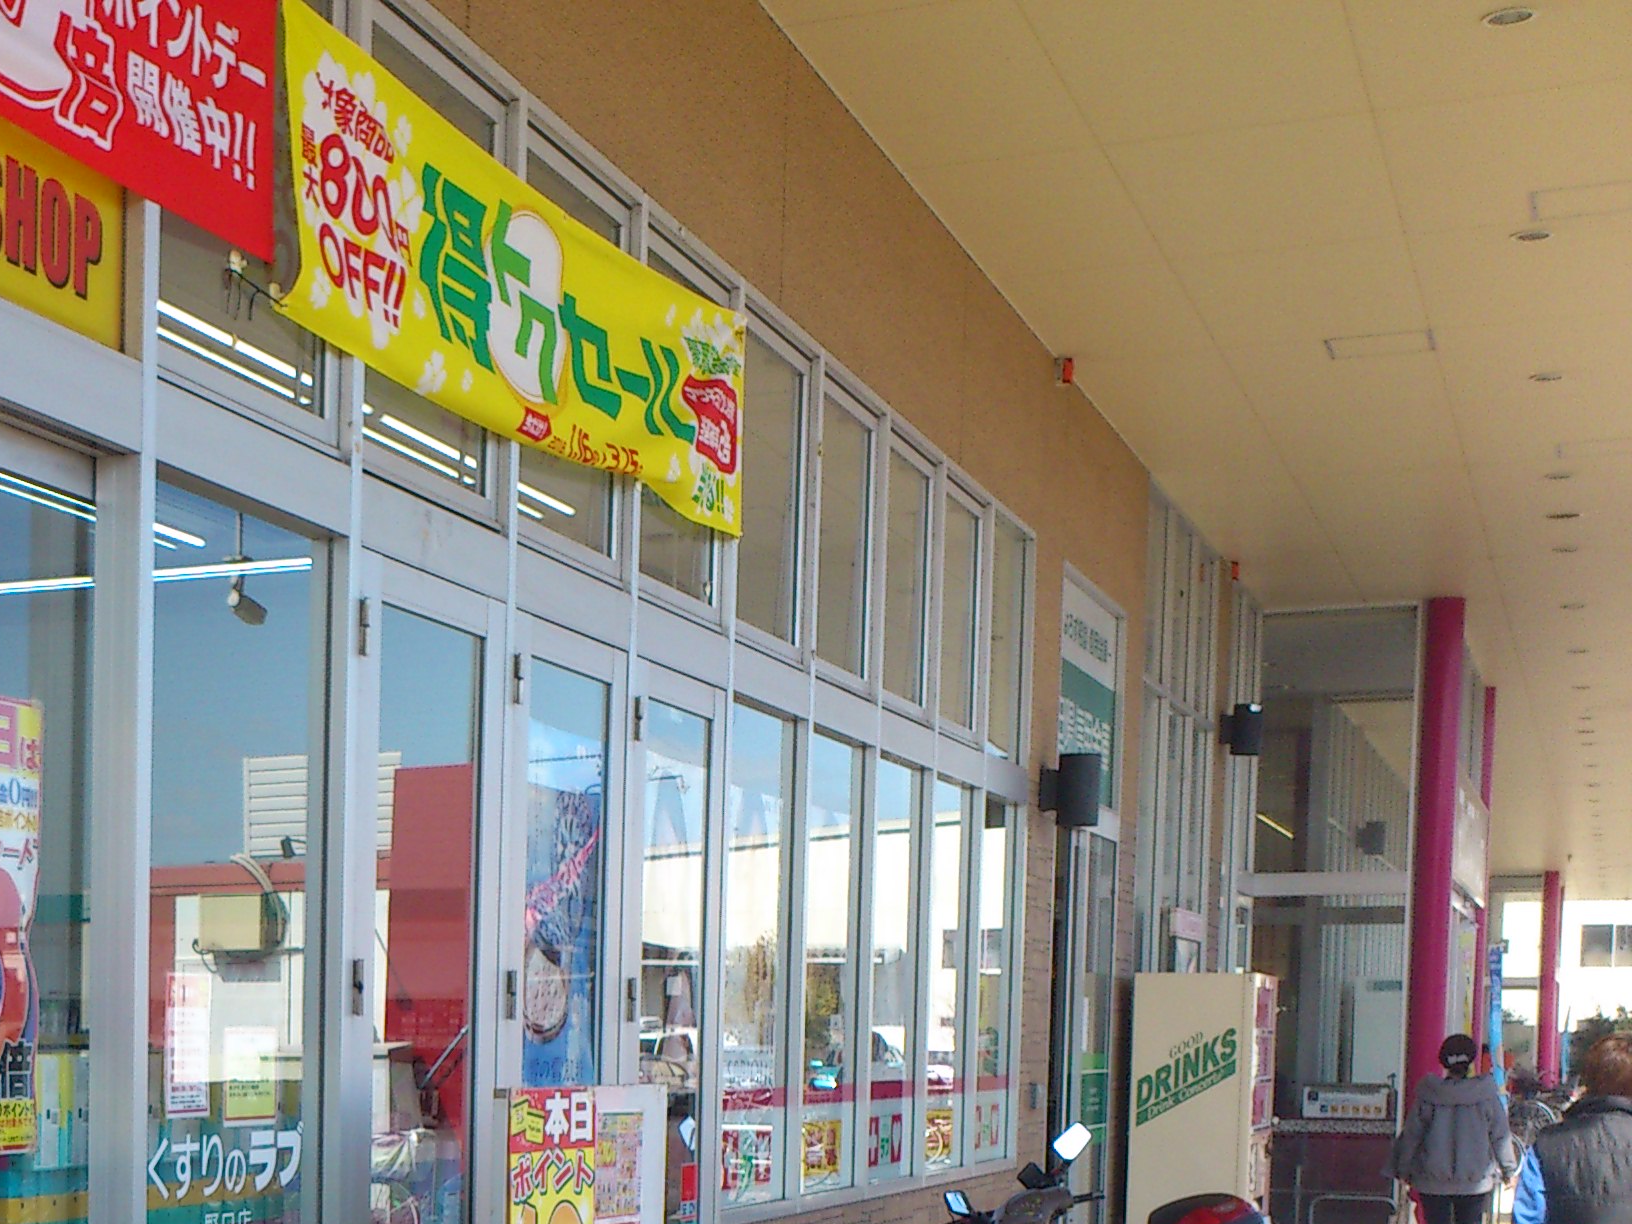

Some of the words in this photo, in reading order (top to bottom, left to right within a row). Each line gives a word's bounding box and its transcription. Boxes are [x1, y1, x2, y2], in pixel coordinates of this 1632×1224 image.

[319, 222, 406, 328] OFF!!
[1137, 1027, 1237, 1110] DRINKS
[1169, 1031, 1204, 1059] GOOD
[545, 1092, 593, 1145] 本日
[148, 1121, 304, 1200] くすりのラブ
[511, 1148, 594, 1205] ポイント
